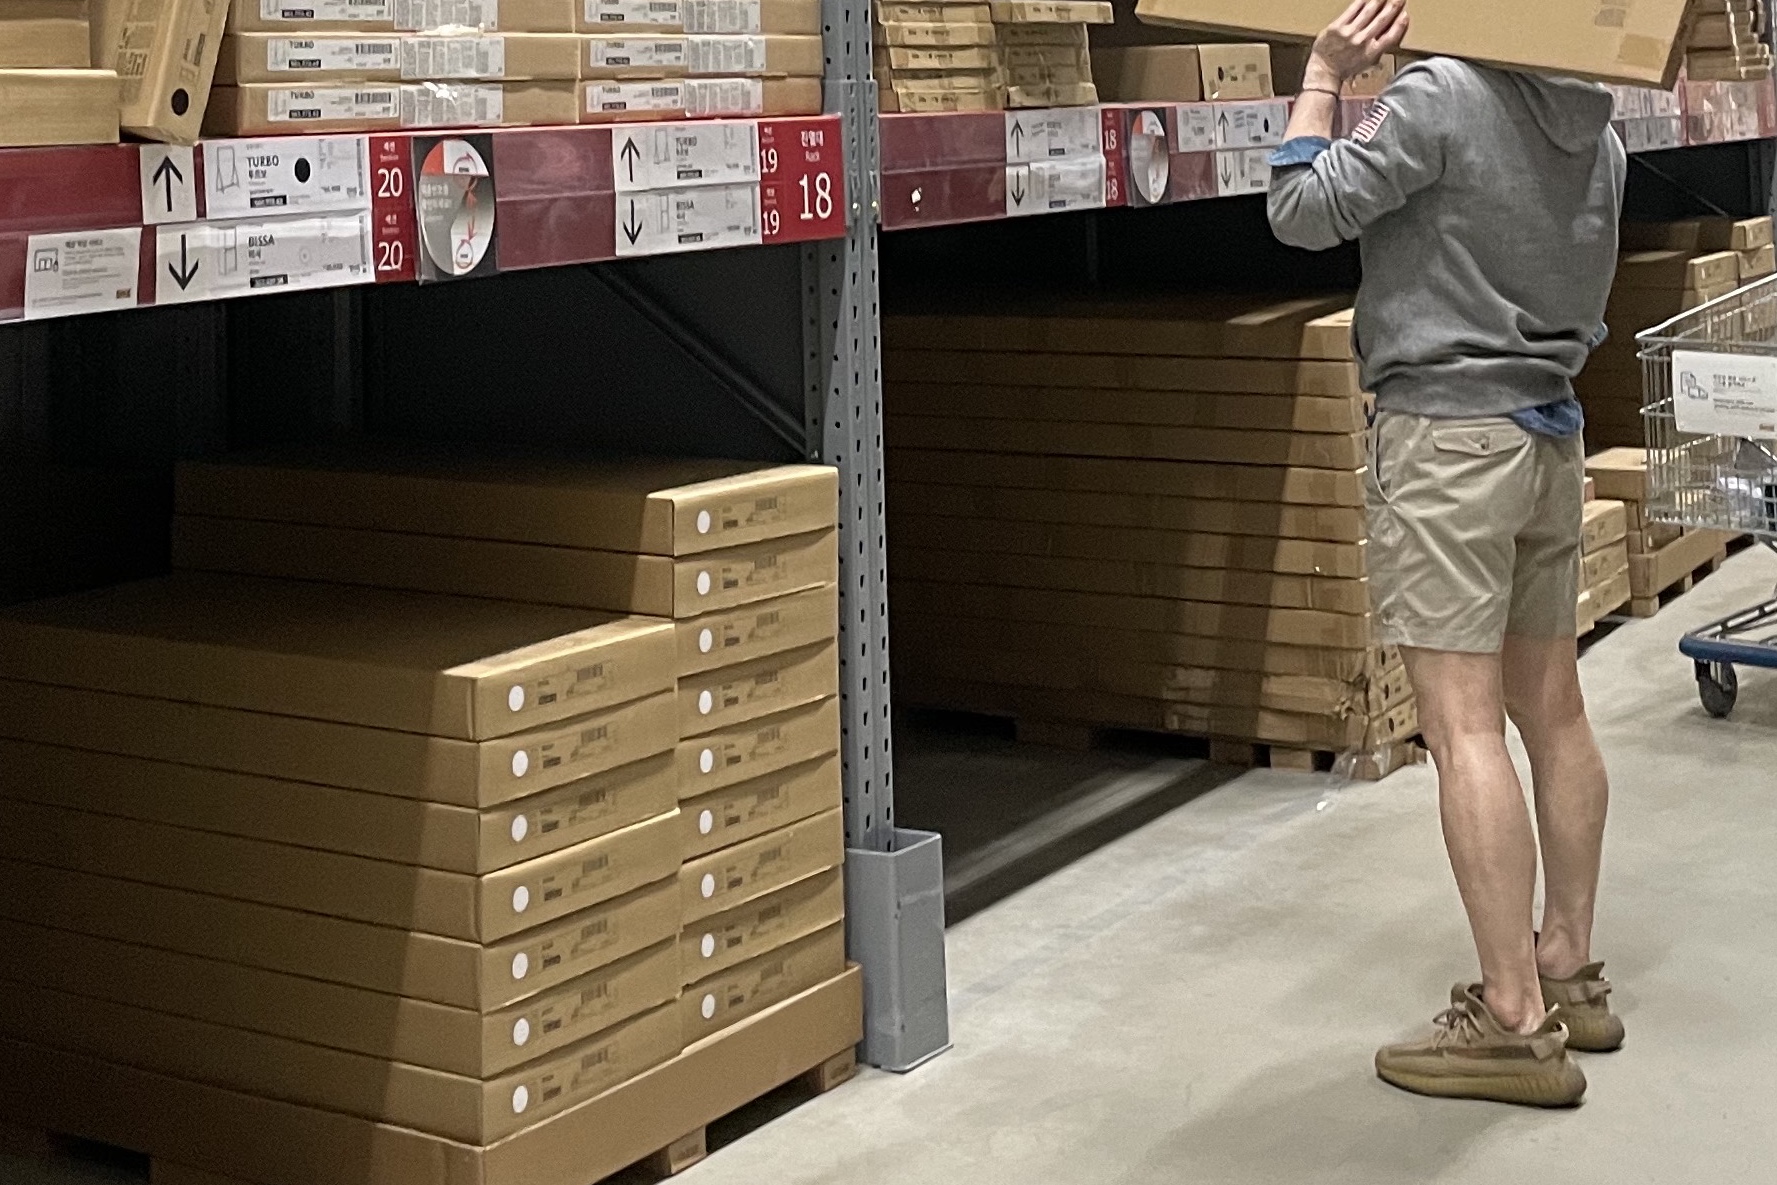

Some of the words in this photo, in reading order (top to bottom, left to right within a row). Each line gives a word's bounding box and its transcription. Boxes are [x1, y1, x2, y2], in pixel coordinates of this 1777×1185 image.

[1104, 129, 1117, 150] 18
[246, 154, 279, 168] TURBO
[760, 148, 778, 173] 19
[377, 167, 403, 198] 20
[1106, 178, 1119, 201] 18
[799, 172, 832, 219] 18
[763, 209, 780, 235] 19
[248, 234, 275, 247] BISSA
[378, 240, 404, 271] 20
